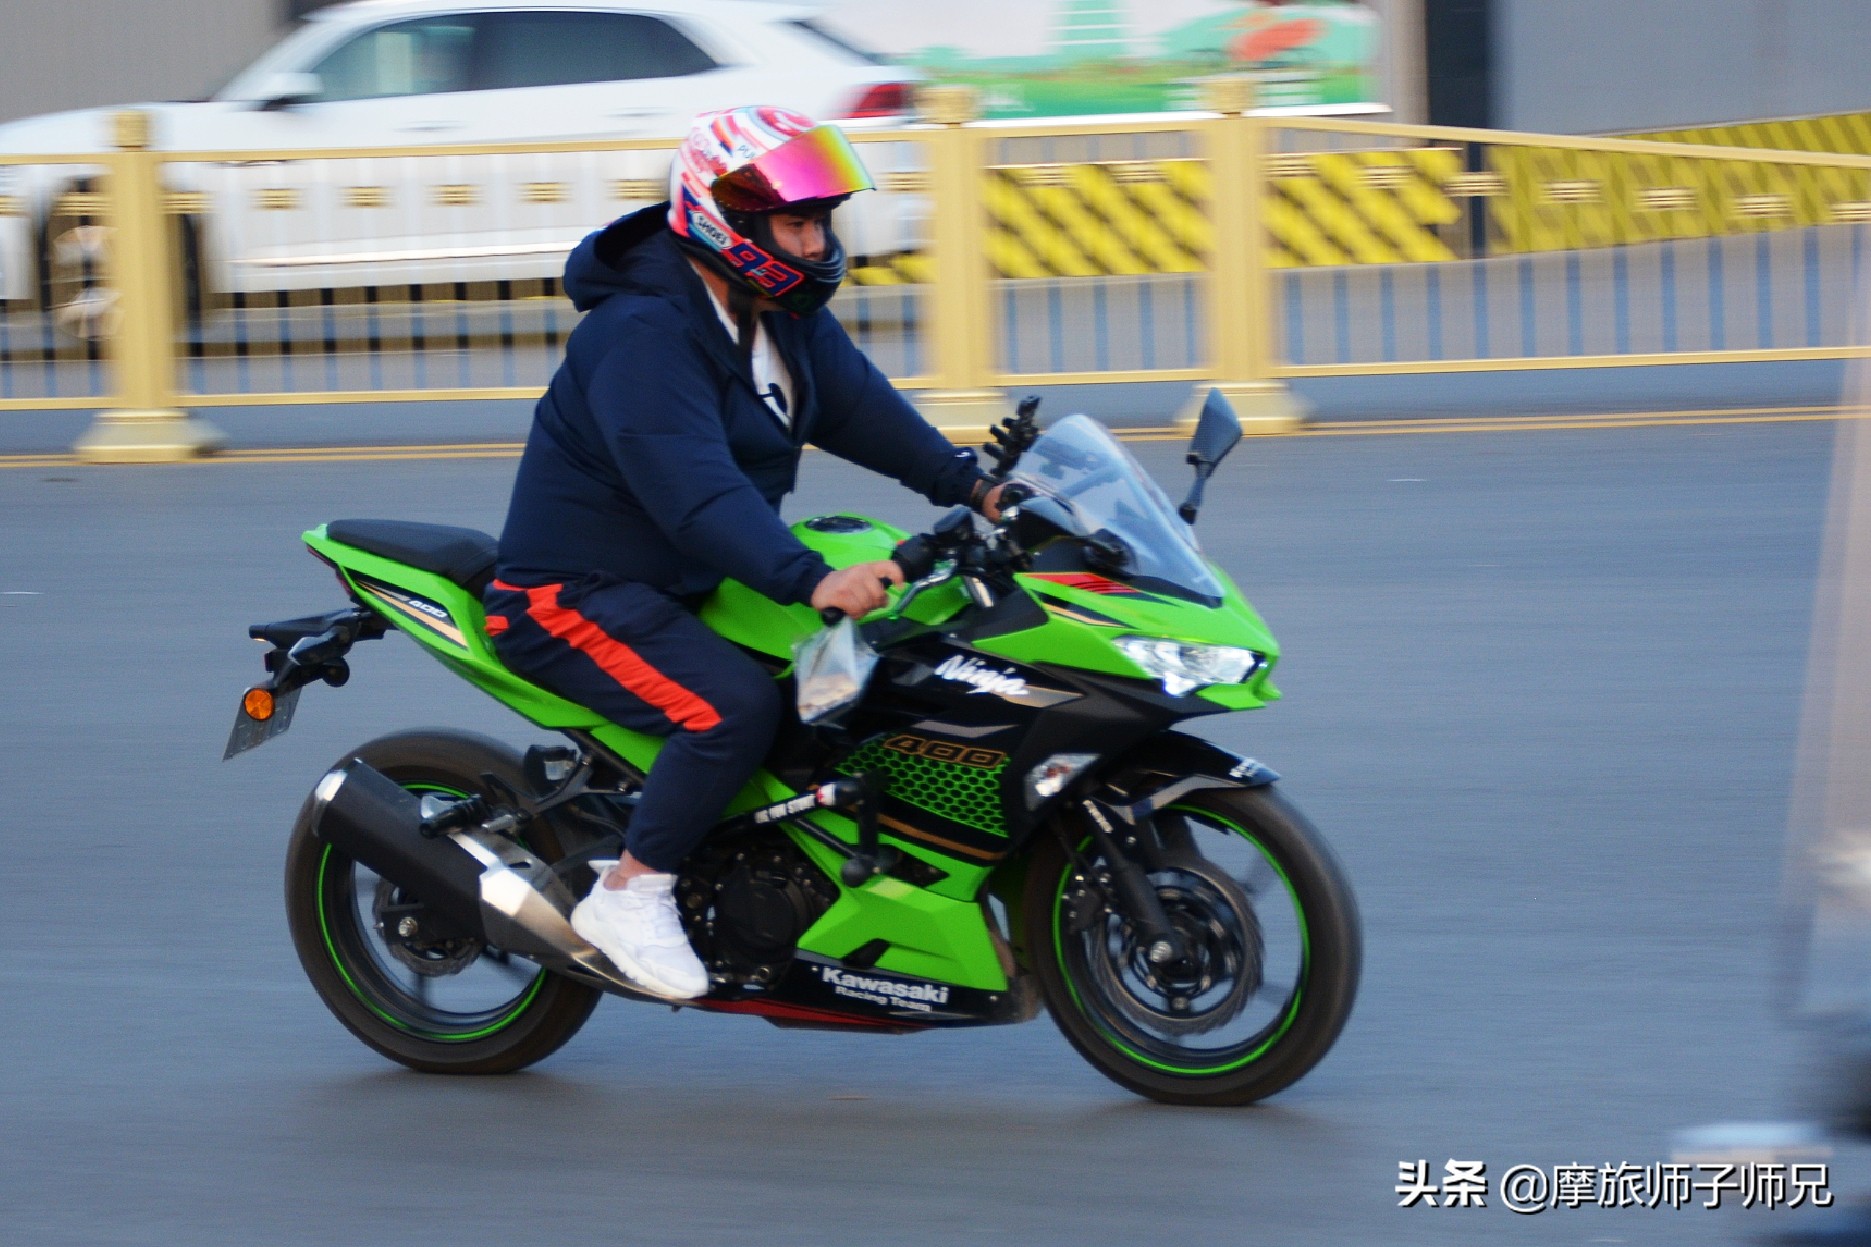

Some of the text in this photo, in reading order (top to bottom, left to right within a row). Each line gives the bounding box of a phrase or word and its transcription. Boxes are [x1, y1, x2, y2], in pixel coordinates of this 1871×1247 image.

[934, 655, 1029, 695] Ninja
[883, 735, 1007, 769] 400
[822, 966, 949, 1004] Kawasaki
[835, 986, 931, 1012] Racing Team
